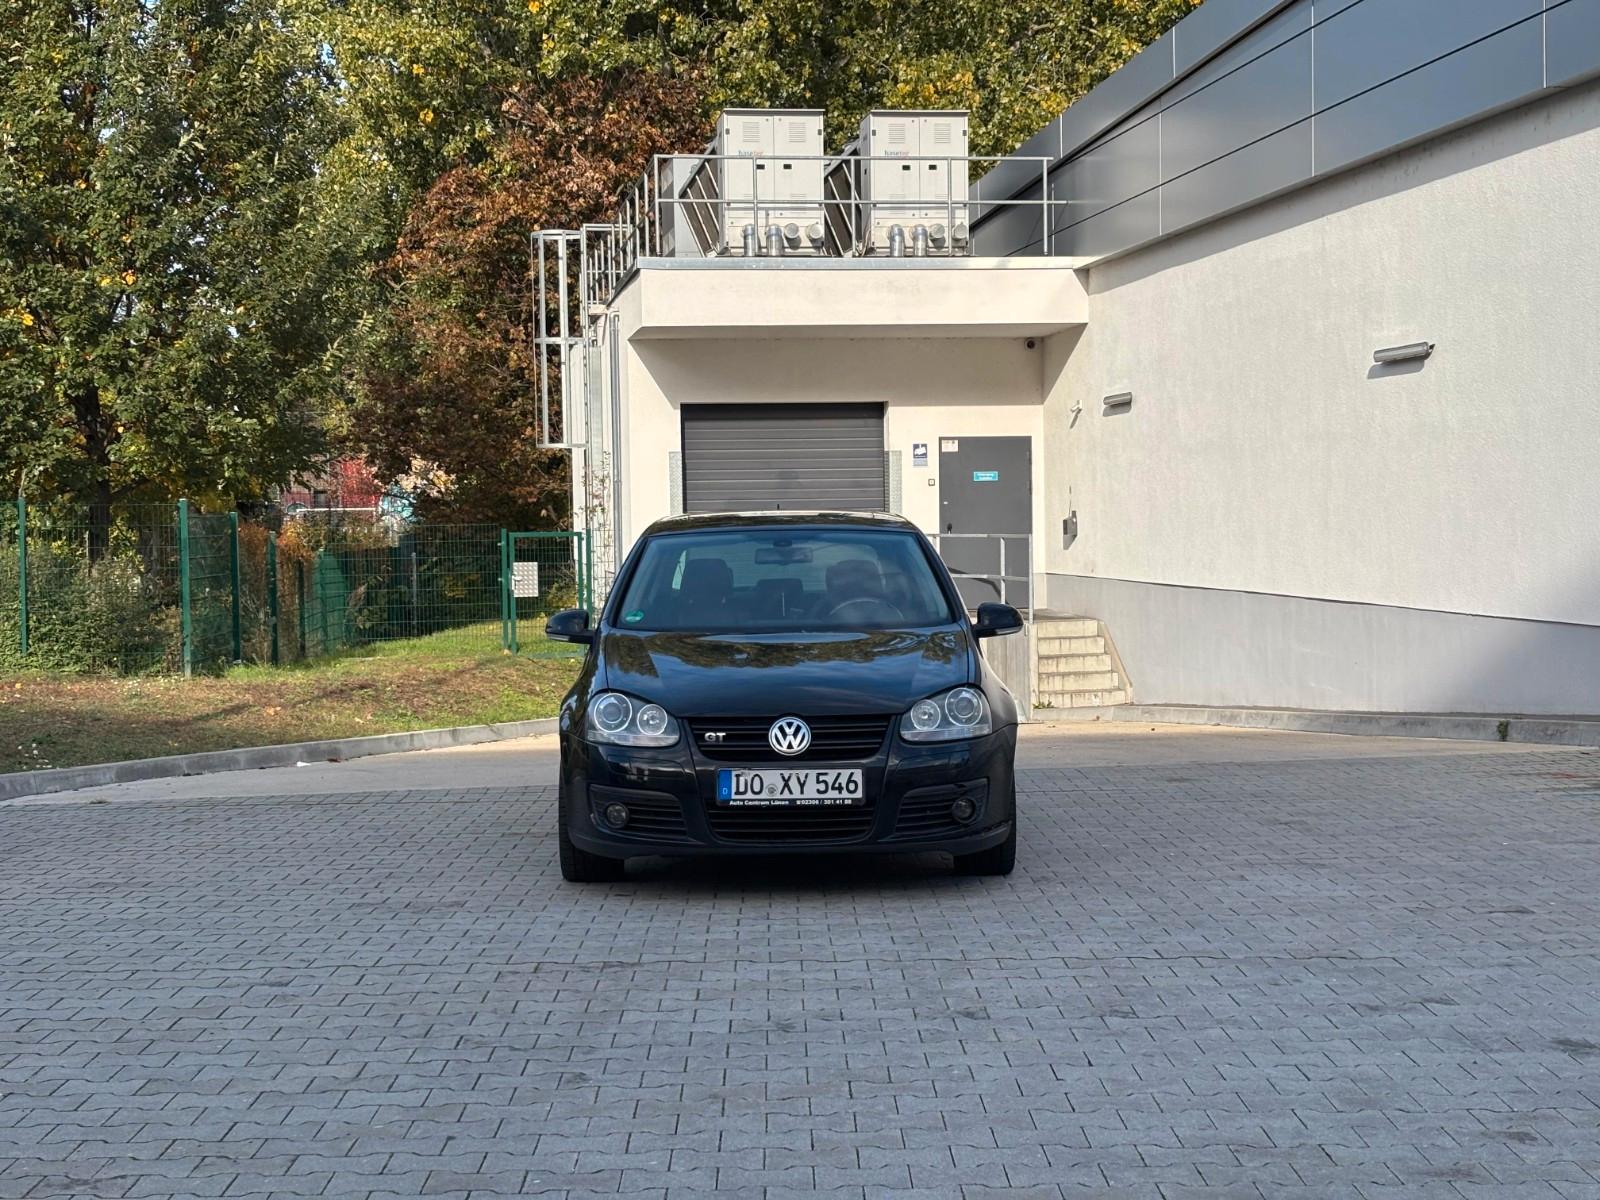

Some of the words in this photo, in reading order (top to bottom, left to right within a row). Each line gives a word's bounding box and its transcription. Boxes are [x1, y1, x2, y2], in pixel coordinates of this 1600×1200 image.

[704, 732, 726, 742] GT
[769, 717, 811, 756] VW
[734, 773, 764, 796] DO
[779, 773, 809, 795] XY
[815, 772, 859, 795] 546
